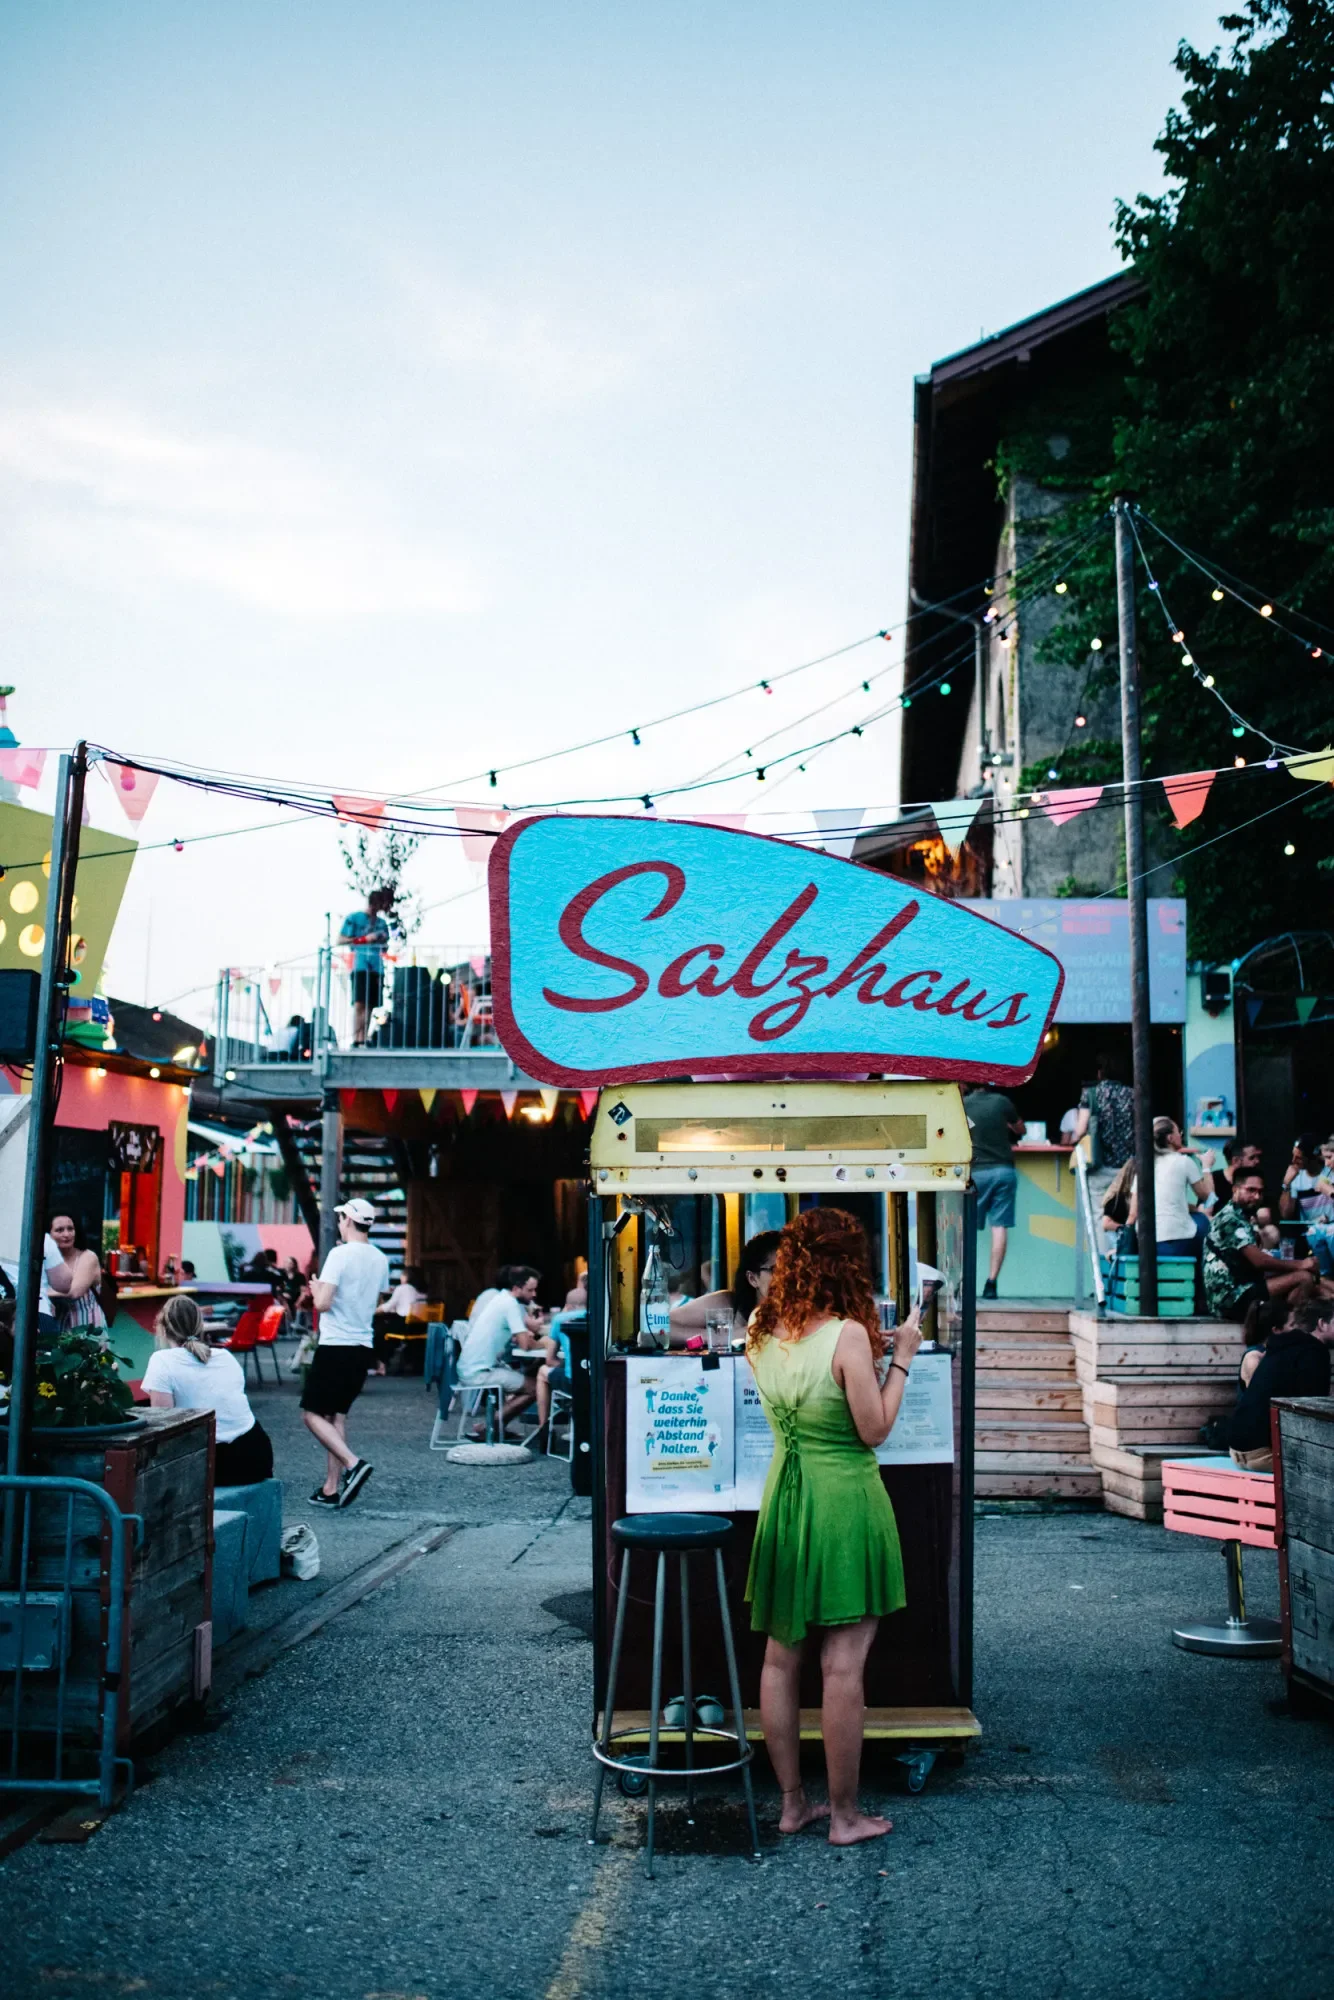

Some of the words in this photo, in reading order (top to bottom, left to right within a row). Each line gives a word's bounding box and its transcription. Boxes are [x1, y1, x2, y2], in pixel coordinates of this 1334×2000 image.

[542, 859, 1031, 1042] Salzhaus
[660, 1390, 700, 1403] Danke,
[657, 1403, 684, 1414] dass
[686, 1403, 704, 1414] Sie
[653, 1416, 708, 1428] weiterhin
[656, 1430, 705, 1441] Abstand
[660, 1443, 700, 1454] halten.
